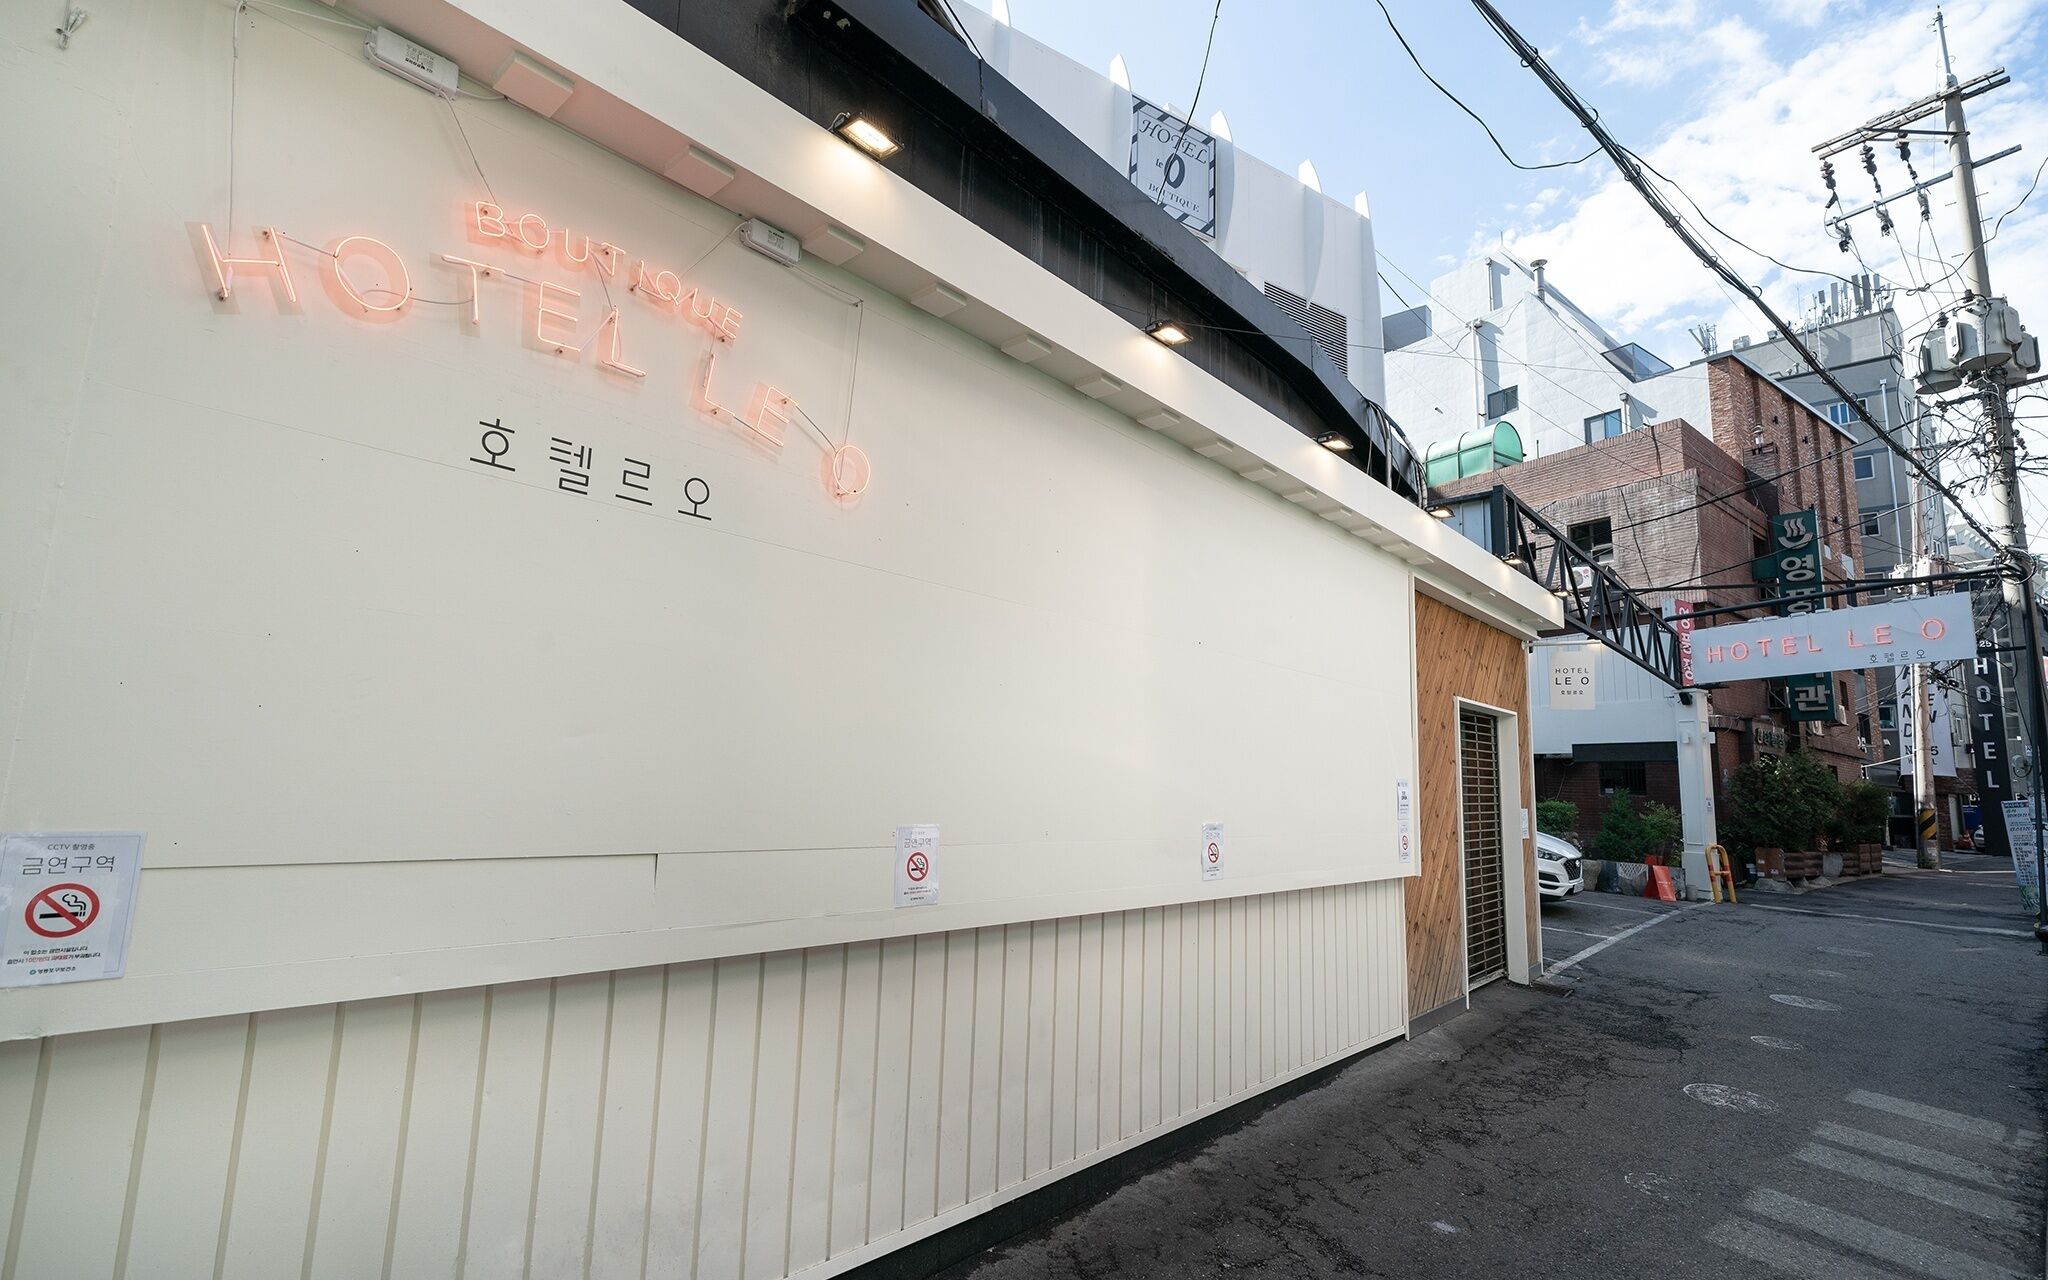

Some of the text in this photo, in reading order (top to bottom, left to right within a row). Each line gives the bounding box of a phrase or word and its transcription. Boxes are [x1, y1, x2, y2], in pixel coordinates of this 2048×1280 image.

[1139, 119, 1208, 165] HOTEL
[1163, 152, 1186, 190] O
[1148, 183, 1200, 213] BOUTIQUE
[474, 200, 743, 341] BOUTIQUE
[202, 223, 872, 496] HOTEL LE O
[469, 416, 713, 521] 호텔르오
[1707, 618, 1946, 664] HOTEL LE O
[1555, 676, 1590, 686] LE O
[1973, 657, 2000, 789] HOTEL
[22, 855, 116, 876] 금연구역
[47, 843, 71, 851] CCTV
